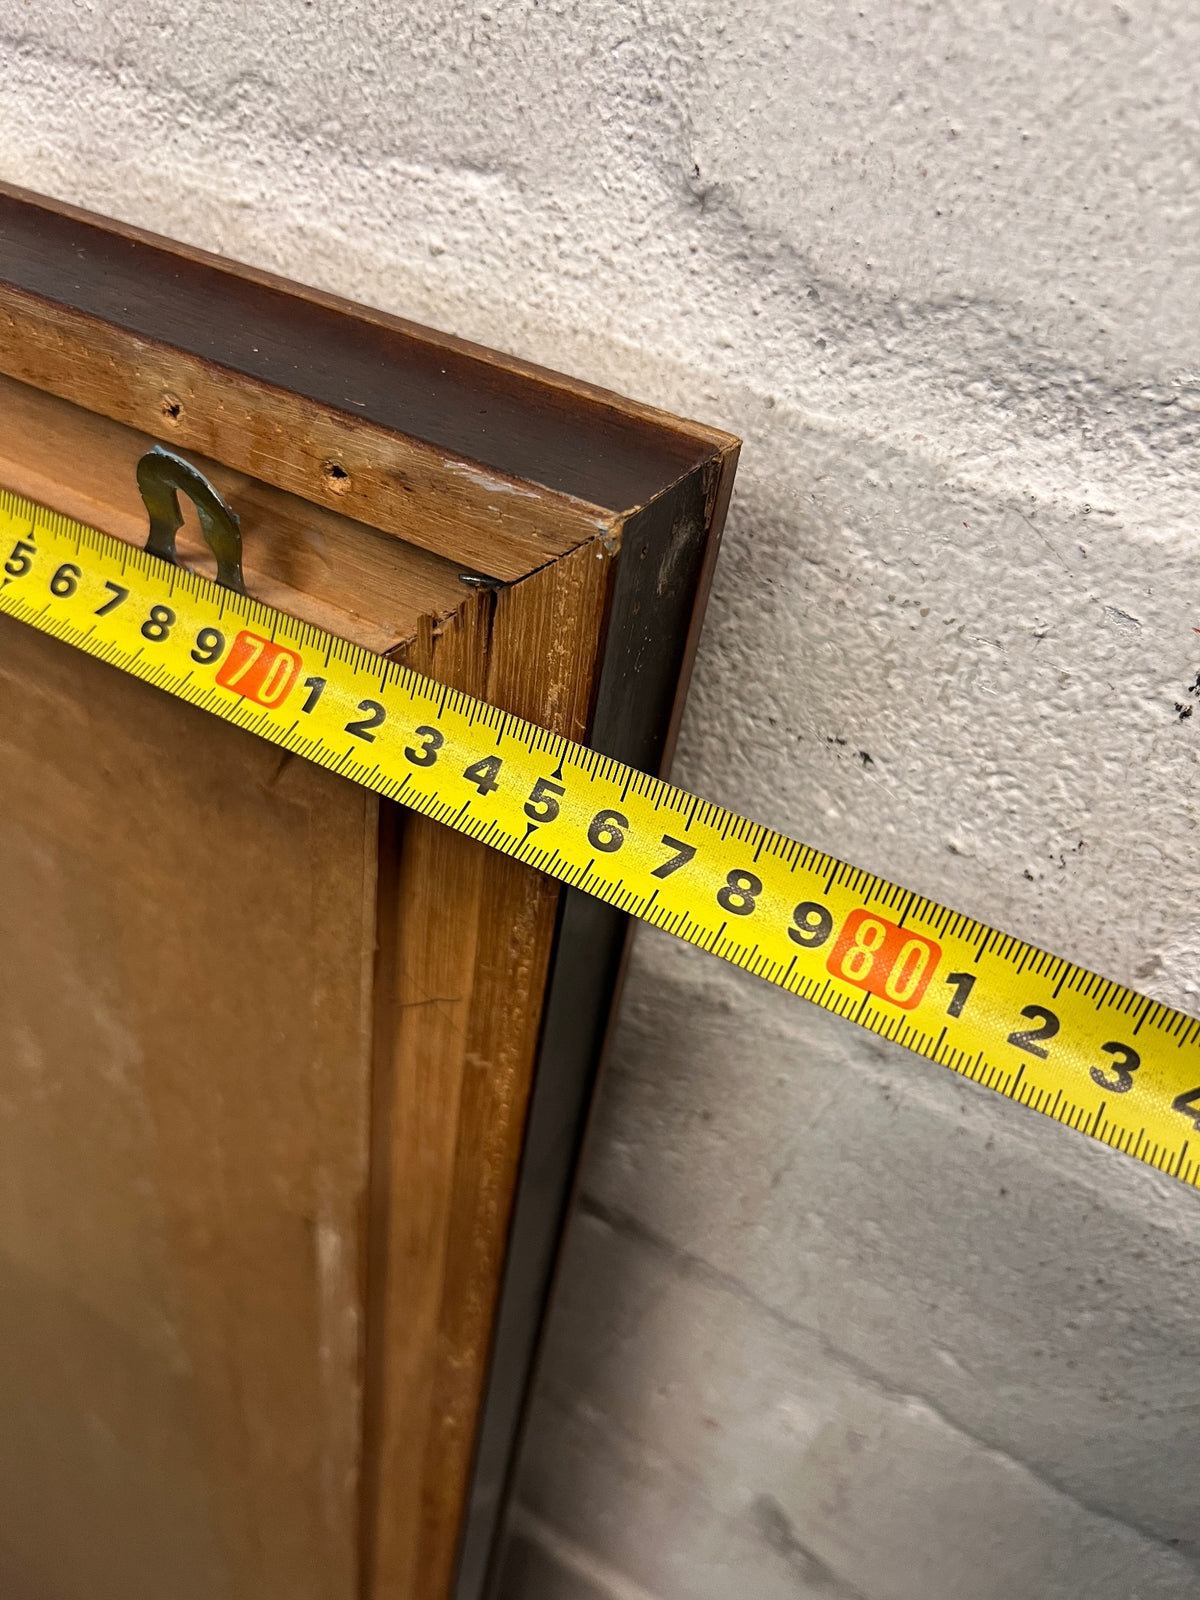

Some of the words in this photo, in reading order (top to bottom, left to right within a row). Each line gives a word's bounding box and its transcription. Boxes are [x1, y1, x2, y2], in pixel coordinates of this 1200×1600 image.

[4, 541, 37, 577] 5
[50, 563, 82, 599] 6
[94, 581, 130, 618] 7
[141, 605, 176, 643] 8
[190, 627, 225, 665] 9
[228, 636, 295, 704] 70
[301, 677, 328, 714] 1
[344, 699, 387, 743] 2
[404, 725, 444, 767] 3
[463, 755, 504, 796] 4
[524, 777, 566, 823] 5
[587, 809, 630, 853] 6
[650, 834, 697, 880] 7
[716, 869, 763, 916] 8
[787, 901, 833, 948] 9
[840, 919, 930, 1003] 80
[945, 972, 977, 1019] 1
[1006, 1004, 1060, 1060] 2
[1090, 1041, 1141, 1094] 3
